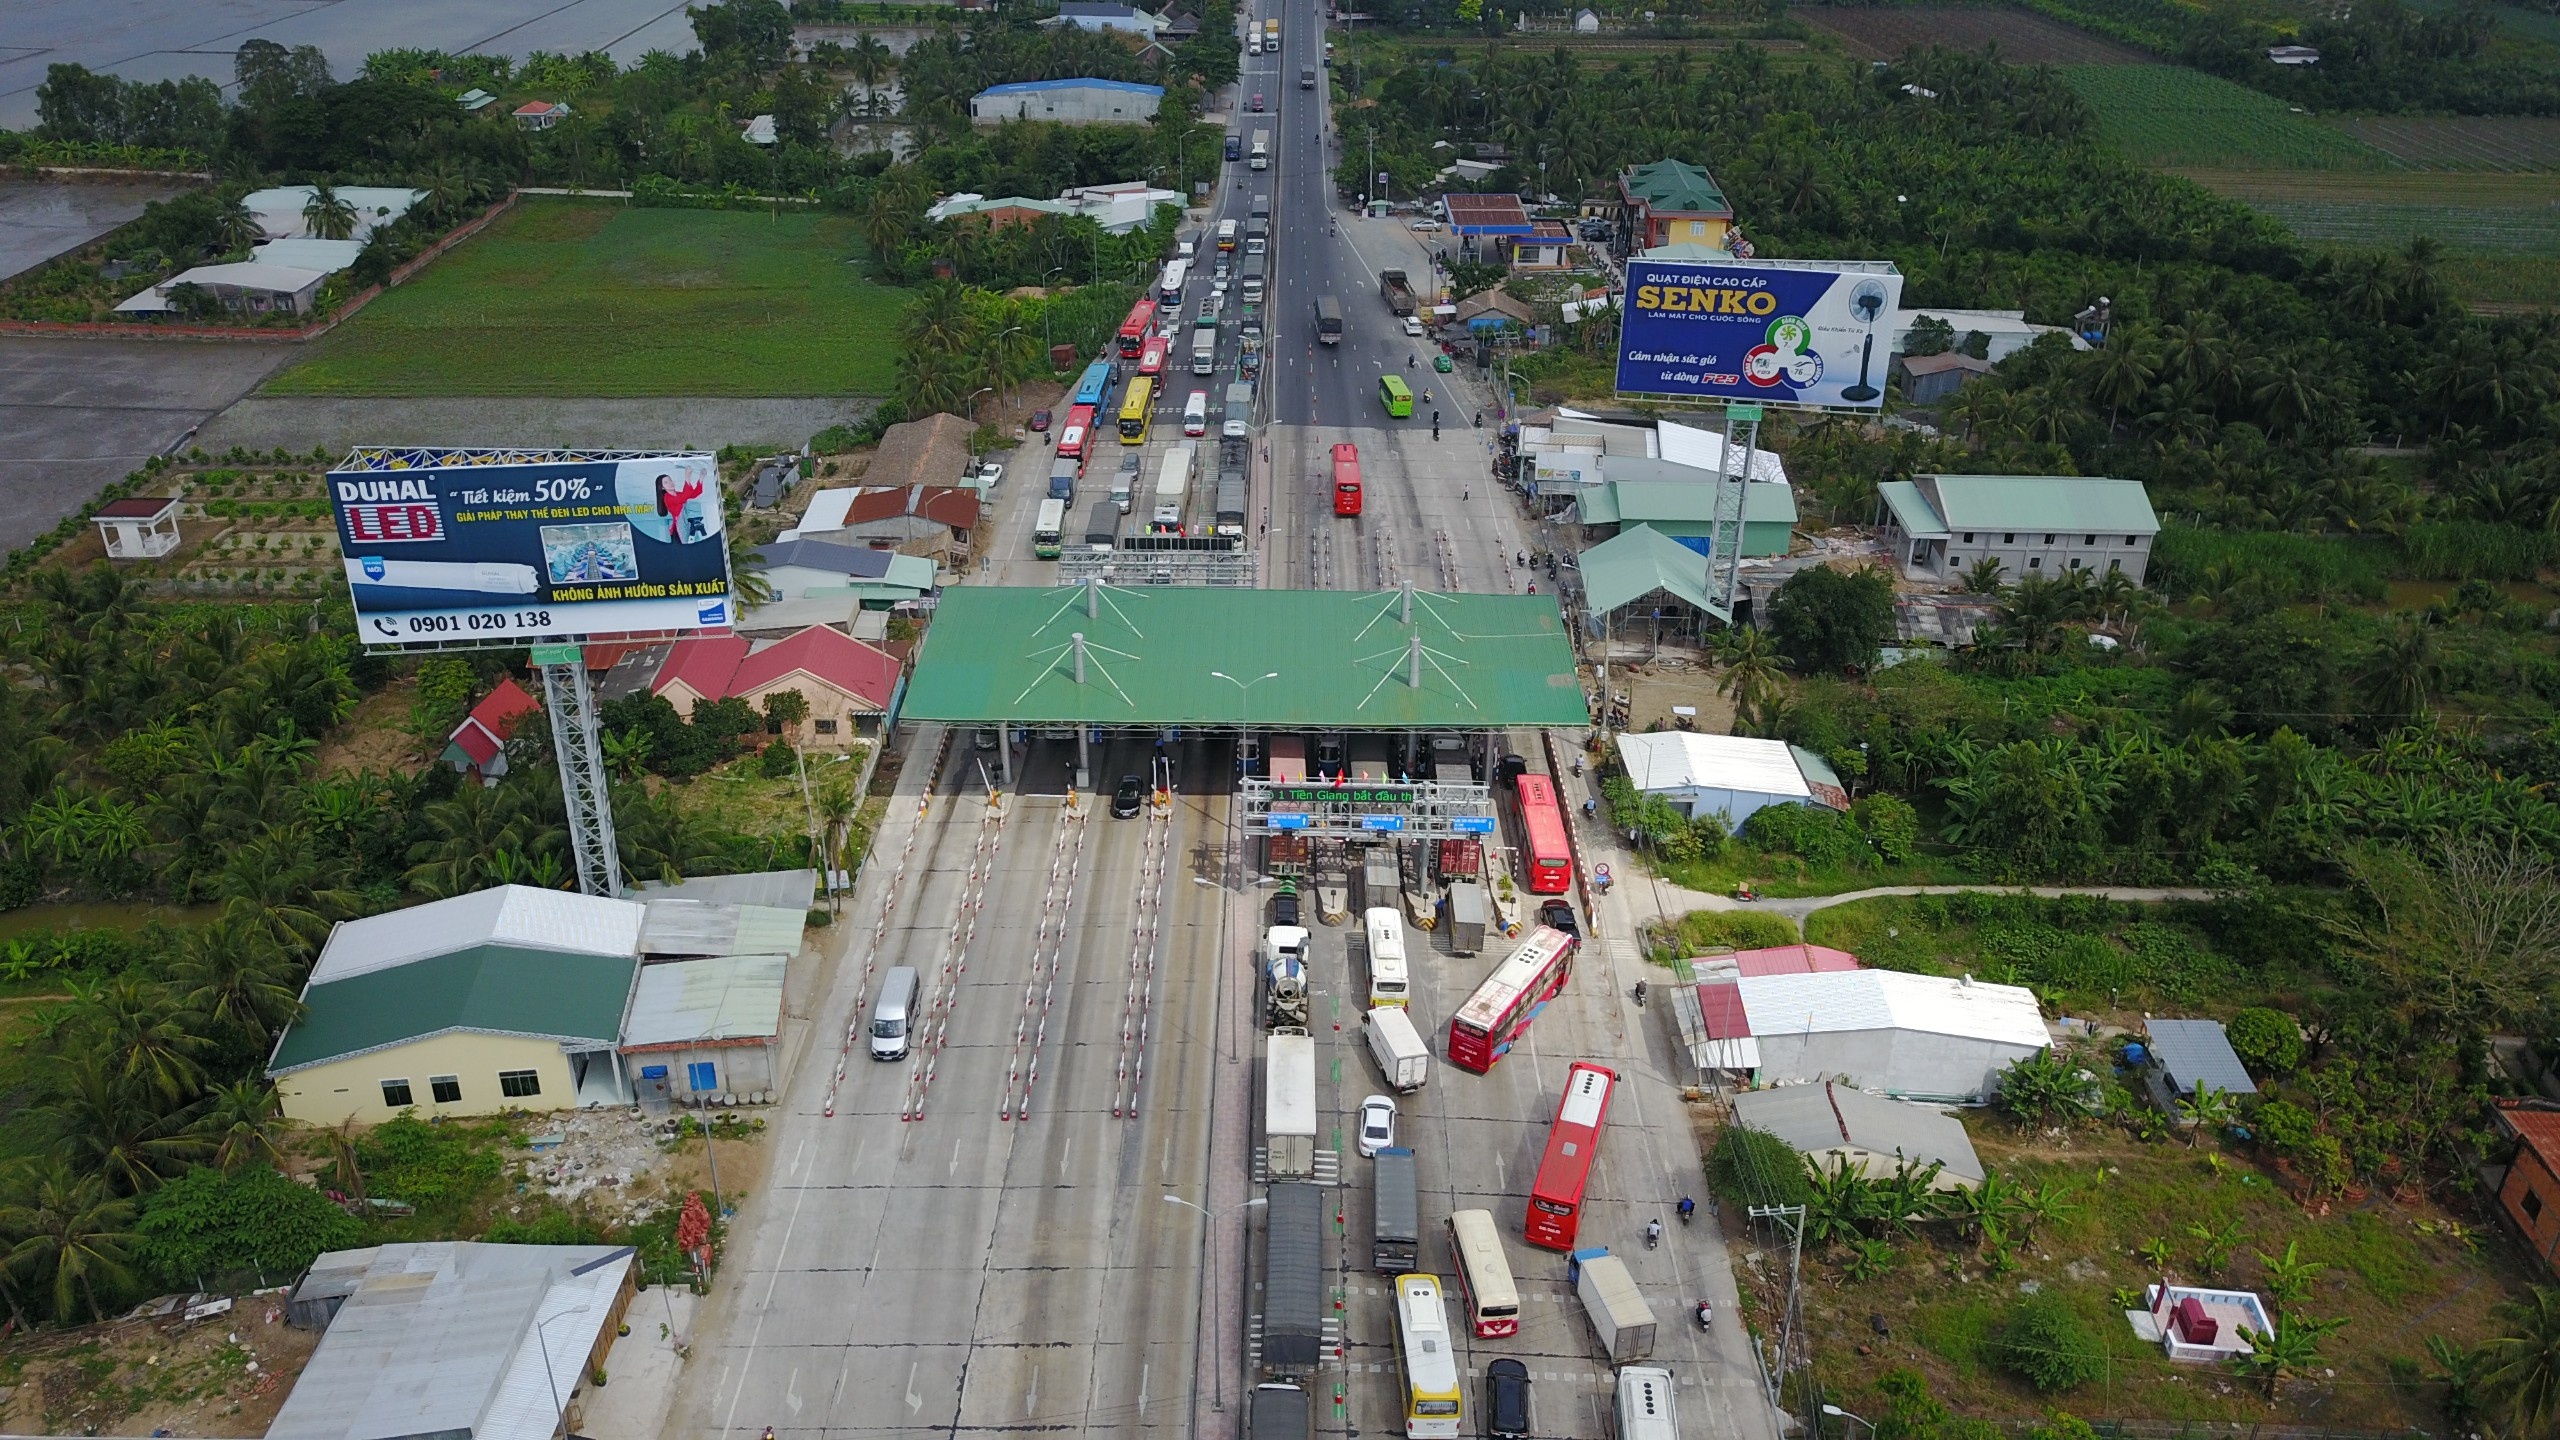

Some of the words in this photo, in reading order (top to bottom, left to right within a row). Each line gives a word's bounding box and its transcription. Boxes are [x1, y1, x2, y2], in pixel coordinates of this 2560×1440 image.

[1646, 273, 1679, 285] QUẠT
[1681, 274, 1711, 286] ĐIỆN
[1712, 277, 1739, 287] CAO
[1741, 276, 1767, 288] CẤP
[1636, 285, 1777, 315] SENKO
[1688, 313, 1707, 321] CHO
[1653, 352, 1679, 364] nhận
[1699, 354, 1717, 366] gió
[1673, 371, 1699, 384] dòng
[1701, 372, 1740, 385] F23
[337, 480, 437, 501] DUHAL
[492, 488, 531, 505] kiệm
[534, 477, 591, 502] 50%
[349, 505, 438, 541] LED
[456, 509, 476, 523] GIẢI
[477, 508, 502, 521] PHÁP
[504, 509, 529, 520] THAY
[531, 505, 549, 518] THẾ
[550, 505, 570, 518] ĐÈN
[572, 507, 589, 517] LED
[592, 506, 611, 516] CHO
[613, 503, 632, 515] NHÀ
[552, 587, 594, 602] KHÔNG
[597, 585, 622, 599] ẢNH
[624, 583, 666, 599] HƯỞNG
[669, 580, 693, 596] SẢN
[695, 577, 726, 595] XUẤT
[409, 615, 460, 633] 0901
[467, 613, 506, 630] 020
[514, 610, 552, 628] 138
[1279, 790, 1285, 800] 1
[1290, 789, 1313, 800] Tiền
[1316, 790, 1350, 802] Giang
[1354, 789, 1372, 801] bắt
[1375, 789, 1397, 801] đầu
